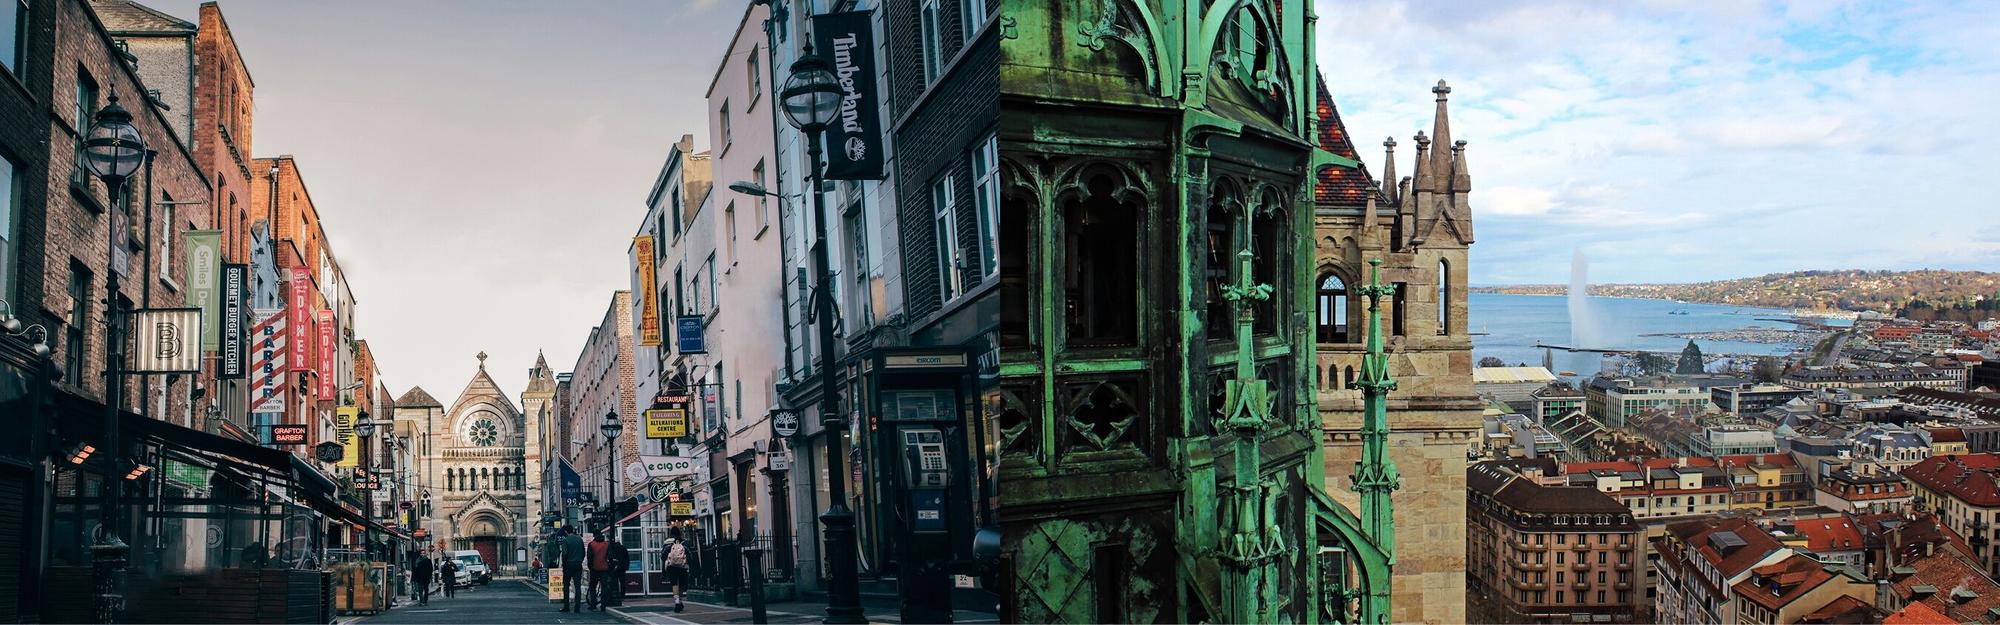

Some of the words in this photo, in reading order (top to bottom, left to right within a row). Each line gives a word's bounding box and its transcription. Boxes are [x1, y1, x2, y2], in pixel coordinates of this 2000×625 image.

[833, 32, 863, 133] Timberland
[199, 250, 209, 285] Smiles
[228, 268, 238, 307] GOURMET
[156, 322, 181, 358] B
[228, 309, 237, 337] BURGER
[296, 296, 304, 368] DINER
[227, 341, 236, 375] KITCHEN
[263, 326, 274, 398] BARBER
[657, 462, 673, 472] cig
[675, 461, 689, 469] co
